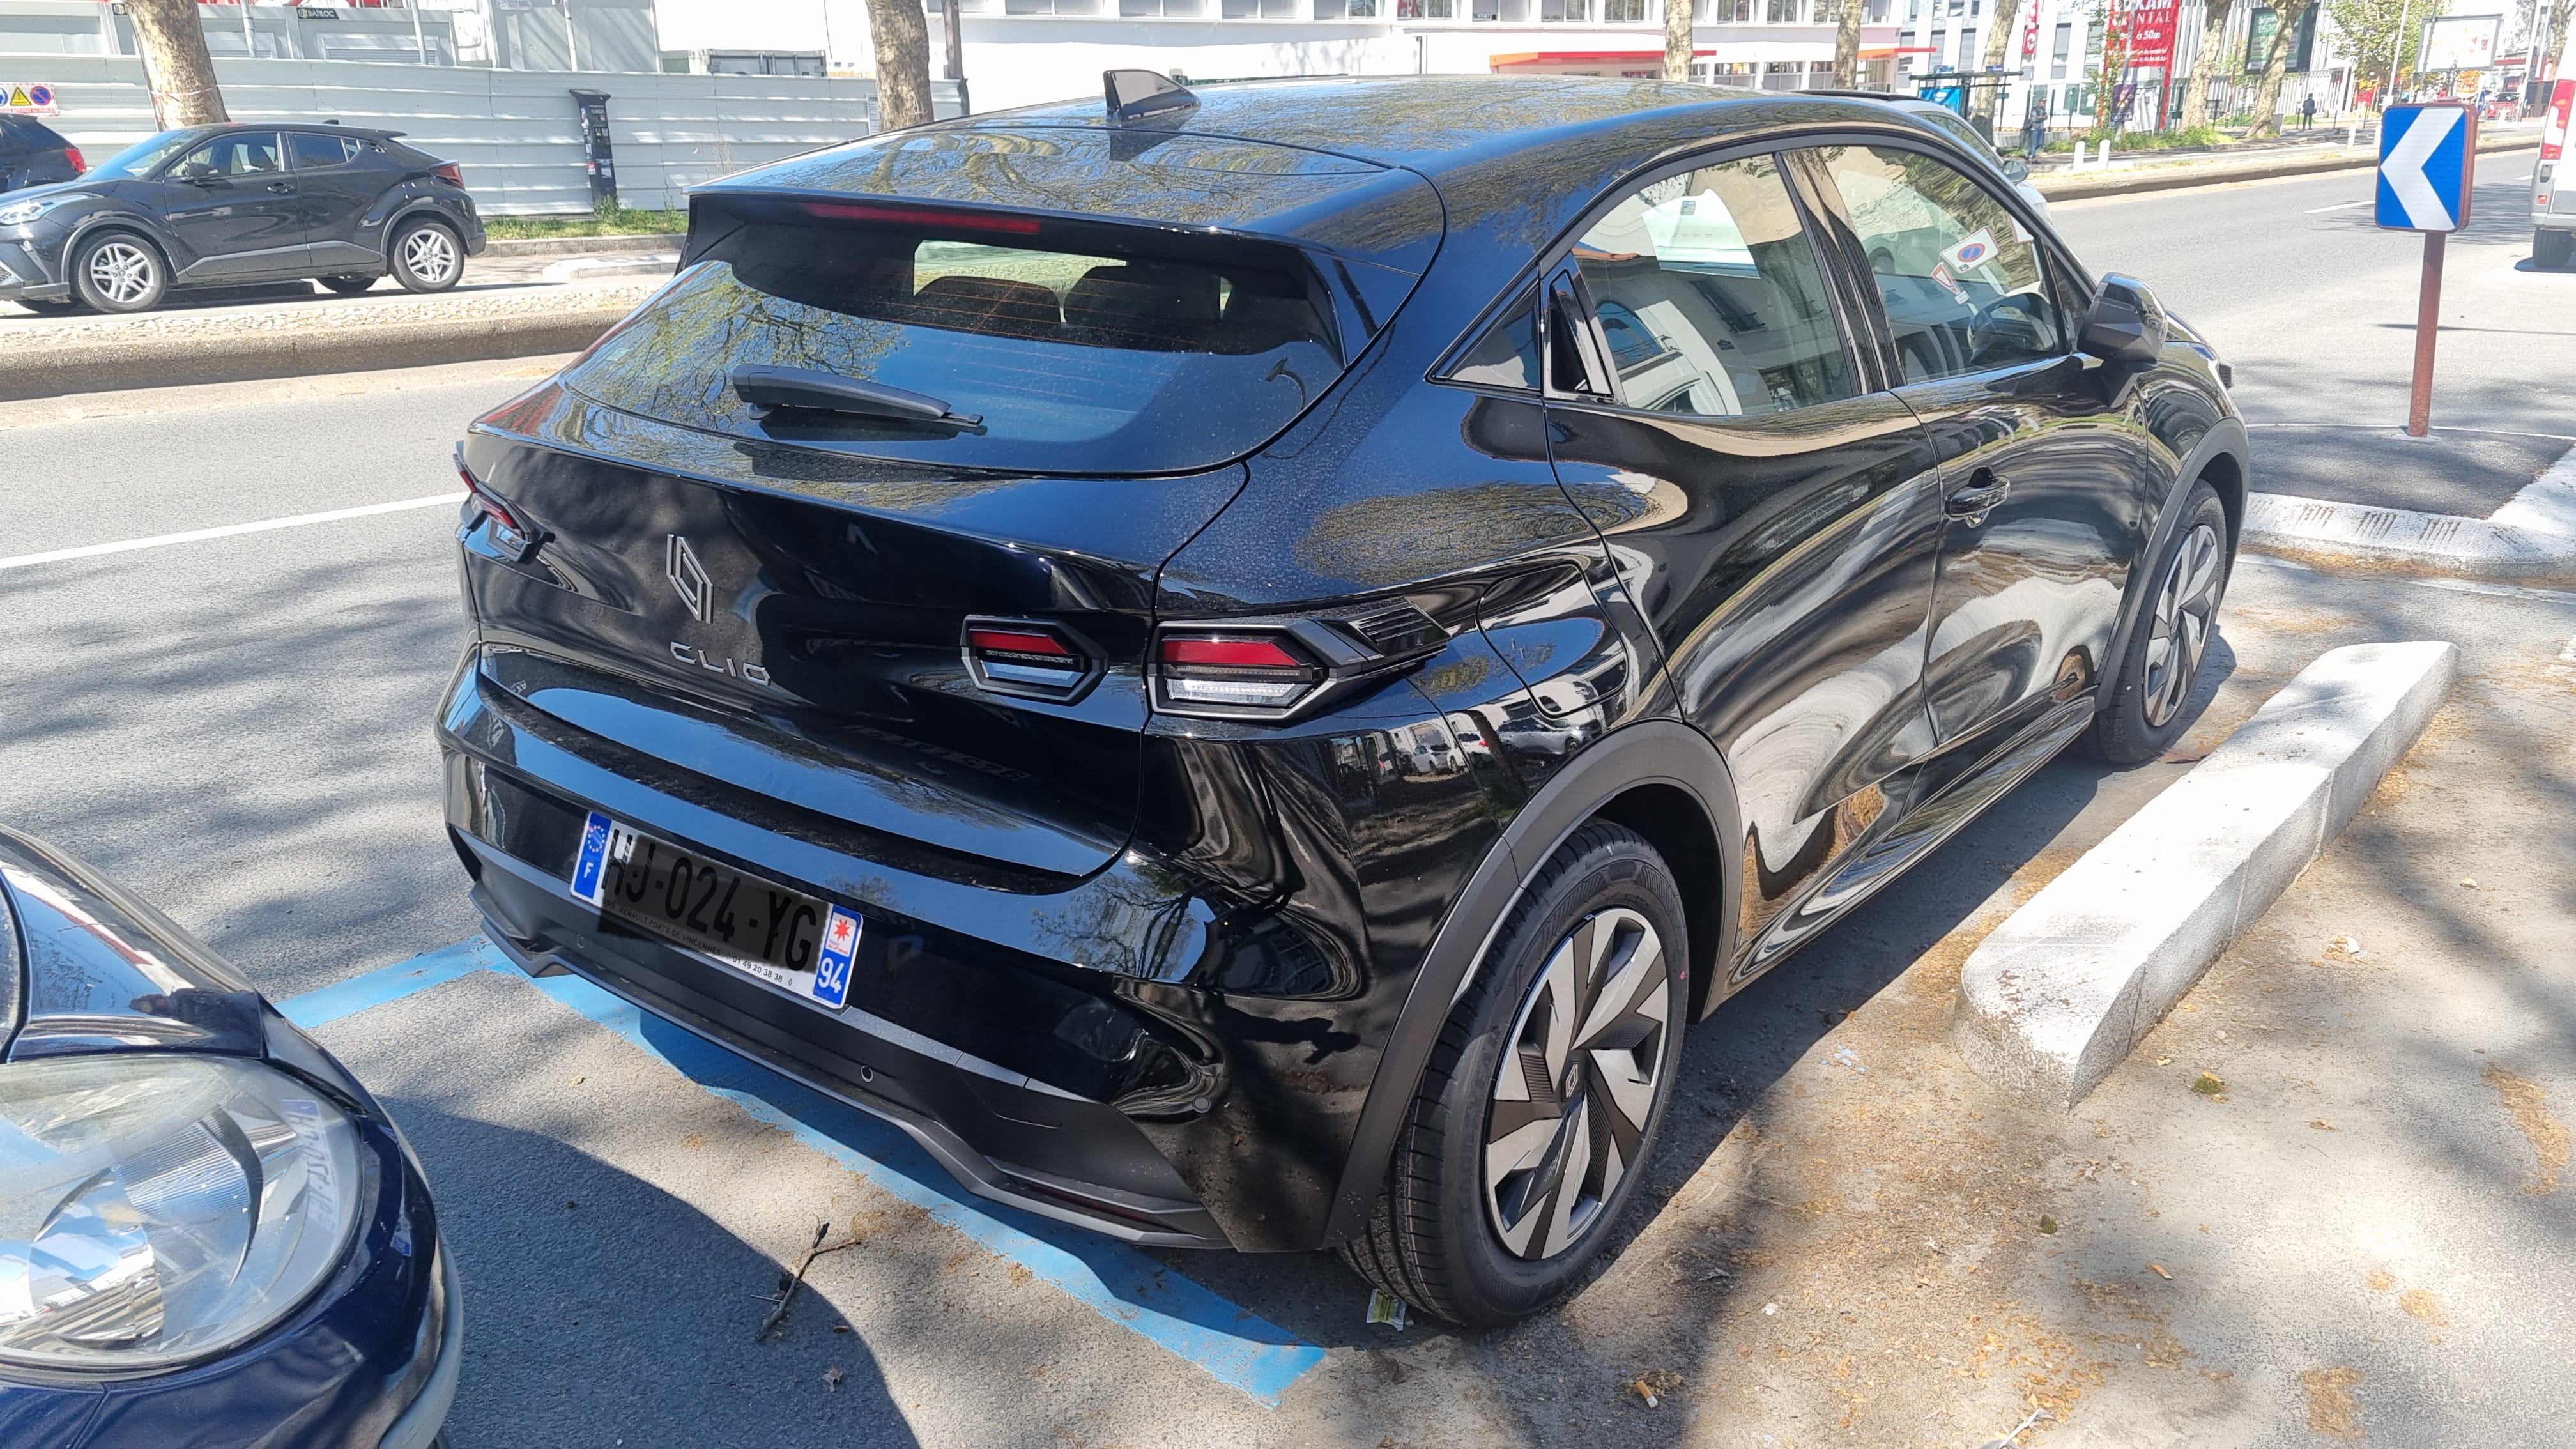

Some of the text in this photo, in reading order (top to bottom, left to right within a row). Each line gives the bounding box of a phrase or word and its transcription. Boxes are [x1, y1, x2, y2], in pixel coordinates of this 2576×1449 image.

[671, 641, 771, 686] CLIO
[583, 861, 594, 878] F
[618, 906, 648, 924] RENAULT
[649, 919, 670, 934] PORTE
[671, 929, 680, 939] DE
[682, 933, 721, 956] VINCENNES
[733, 955, 740, 964] 01
[742, 960, 751, 969] 49
[753, 964, 762, 974] 20
[763, 969, 772, 977] 38
[774, 973, 783, 983] 38
[818, 957, 845, 993] 94
